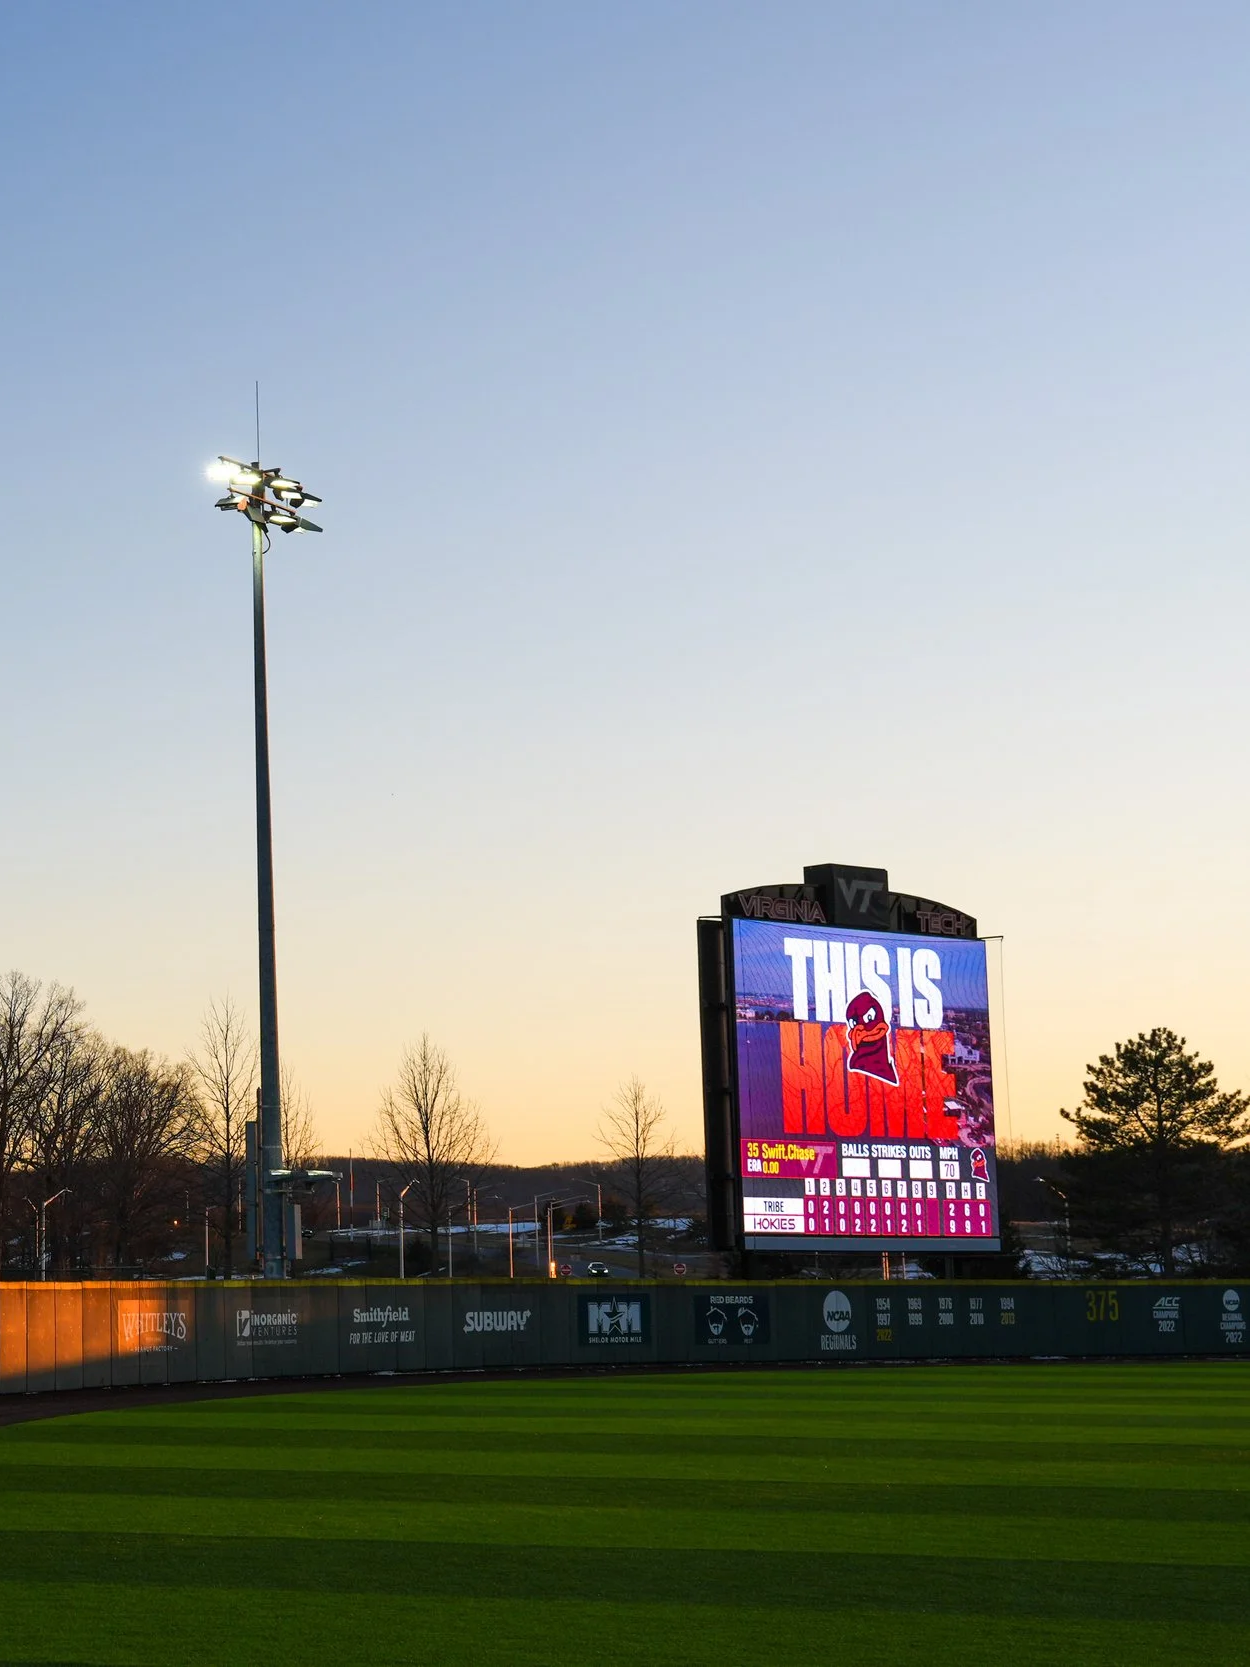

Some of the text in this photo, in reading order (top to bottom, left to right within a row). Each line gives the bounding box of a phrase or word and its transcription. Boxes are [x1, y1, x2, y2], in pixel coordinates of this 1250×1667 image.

[837, 877, 885, 913] VT
[738, 893, 966, 935] VIRGINIA TECH
[784, 938, 944, 1029] THIS IS
[780, 1020, 959, 1139] HOME
[747, 1142, 759, 1158] 35
[841, 1143, 959, 1160] BALLS STRIKES OUTS MPH
[747, 1158, 779, 1174] ERA 0.00
[944, 1163, 956, 1178] 70
[807, 1181, 983, 1196] 1 2 3 4 5 6 7 8 9 R H E
[763, 1200, 985, 1217] TRIBE 0 2 0 0 0 0 0 0 2 6 0
[753, 1218, 985, 1233] HOKIES 0 1 0 2 2 1 2 1 9 9 1
[710, 1296, 754, 1304] RED BEARDS
[876, 1298, 890, 1310] 1954
[1085, 1290, 1119, 1320] 375
[1154, 1297, 1181, 1306] ACC
[353, 1305, 410, 1328] Smithfield
[463, 1310, 531, 1333] SUBWAY
[826, 1311, 850, 1321] NCAA
[877, 1313, 890, 1325] 1997
[1153, 1310, 1179, 1319] CHAMPIONS
[122, 1312, 187, 1342] WHITLEY'S
[251, 1326, 298, 1336] VENTURES
[1158, 1321, 1175, 1332] 2022
[350, 1331, 416, 1344] FOR THE LOVE OF MEAT
[821, 1334, 857, 1350] REGIONALS
[1225, 1331, 1243, 1343] 2022
